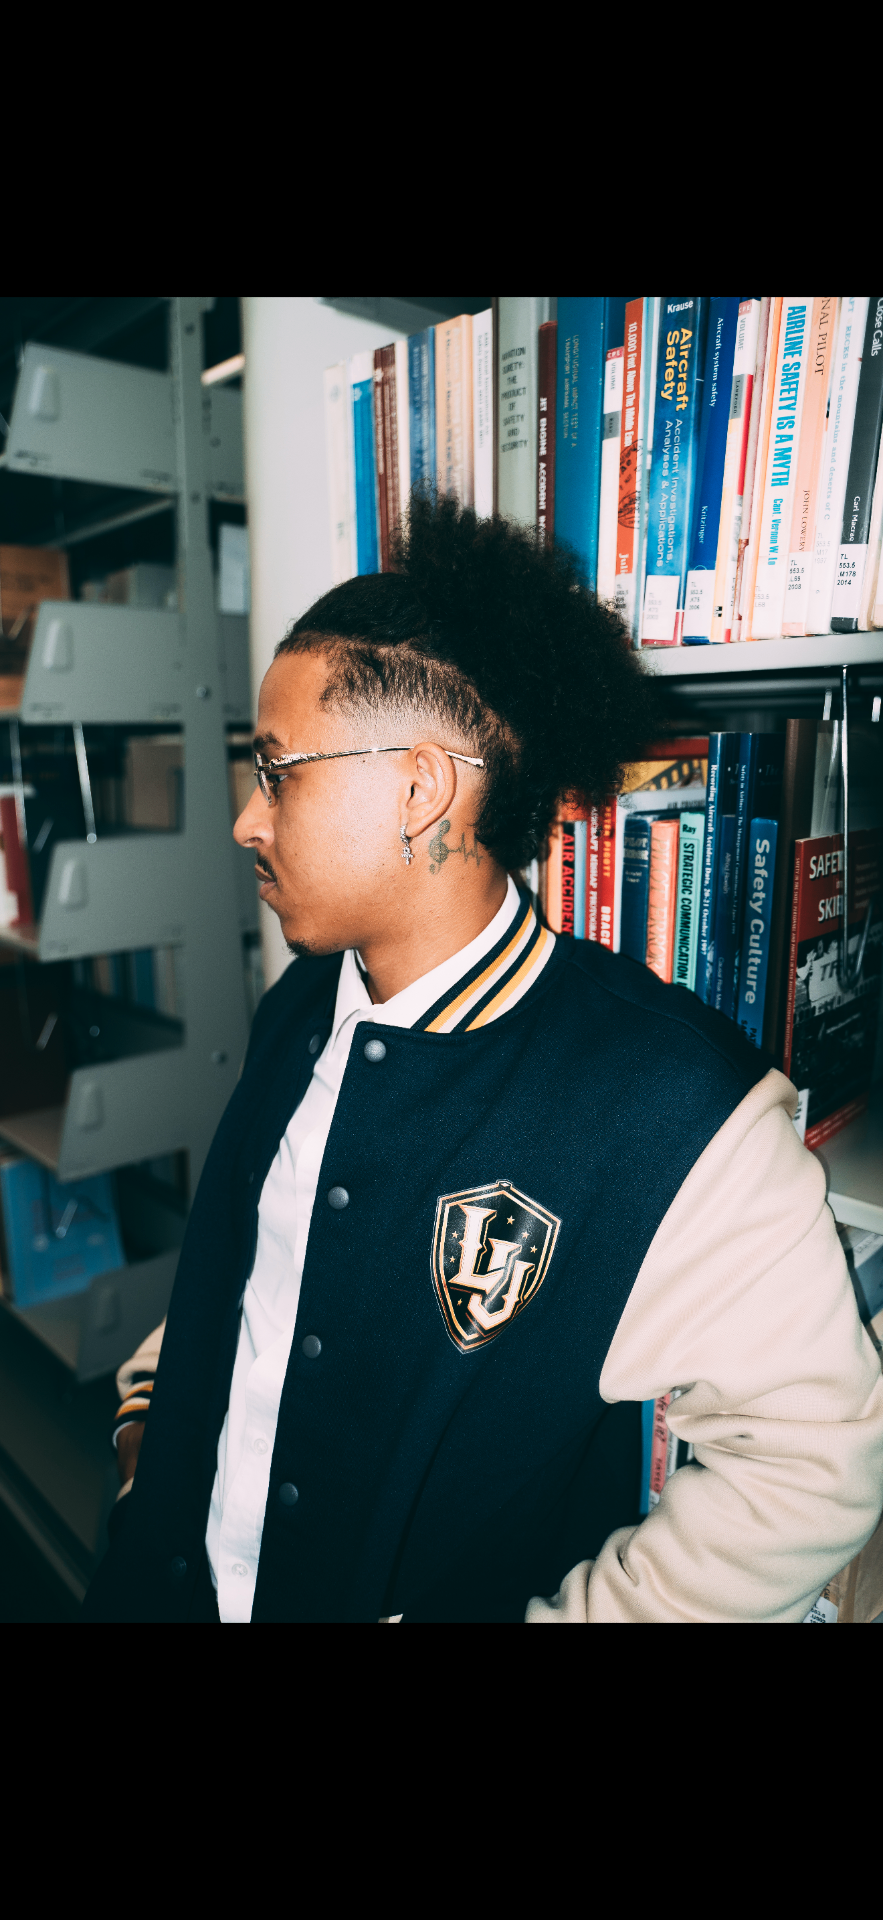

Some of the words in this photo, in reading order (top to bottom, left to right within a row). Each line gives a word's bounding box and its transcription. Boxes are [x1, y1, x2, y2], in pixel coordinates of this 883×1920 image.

[667, 300, 694, 314] Krause
[739, 304, 751, 313] CPE
[874, 297, 883, 329] Close
[627, 322, 638, 353] 10,000
[715, 318, 724, 350] Aircraft
[737, 317, 747, 351] VOLUME
[783, 305, 807, 360] AIRLINE
[843, 319, 852, 360] RECKS
[871, 330, 883, 357] Calls
[627, 353, 637, 370] Feet
[661, 330, 680, 401] Safety
[712, 351, 720, 381] system
[815, 332, 828, 376] PILOT
[841, 362, 847, 372] in
[626, 370, 637, 393] Above
[676, 328, 693, 412] Aircraft
[625, 393, 636, 408] The
[709, 382, 719, 407] safety
[778, 361, 801, 411] SAFETY
[539, 397, 547, 411] JET
[833, 394, 843, 443] mountains
[539, 417, 547, 456] ENGINE
[776, 415, 795, 430] IS
[662, 420, 673, 477] Analyses
[671, 418, 683, 477] Accident
[775, 434, 794, 444] A
[831, 446, 840, 463] and
[771, 447, 792, 487] MYTH
[826, 466, 836, 499] deserts
[538, 462, 547, 510] ACCIDENT
[661, 481, 670, 489] &
[772, 498, 783, 517] Capt.
[802, 490, 810, 514] JOHN
[825, 502, 831, 511] of
[852, 496, 861, 512] Carl
[656, 493, 669, 567] Applications
[666, 477, 680, 563] Investigations,
[698, 505, 708, 544] Kritzinger
[770, 519, 781, 544] Vernon
[798, 516, 808, 552] LOWERY
[708, 764, 718, 801] Recording
[603, 806, 612, 837] PETER
[682, 823, 697, 834] Ray
[707, 803, 716, 833] Aircraft
[562, 833, 575, 863] AIR
[603, 841, 611, 878] PIGOTT
[705, 834, 714, 865] Accident
[589, 854, 598, 888] MISHAP
[681, 842, 695, 895] STRATEGIC
[703, 867, 712, 886] Data,
[749, 838, 770, 914] Safety
[809, 851, 844, 880] SAFET
[817, 894, 844, 922] SKIE
[648, 905, 668, 969] ERROR
[676, 897, 692, 979] COMMUNICATION
[744, 918, 765, 1004] Culture
